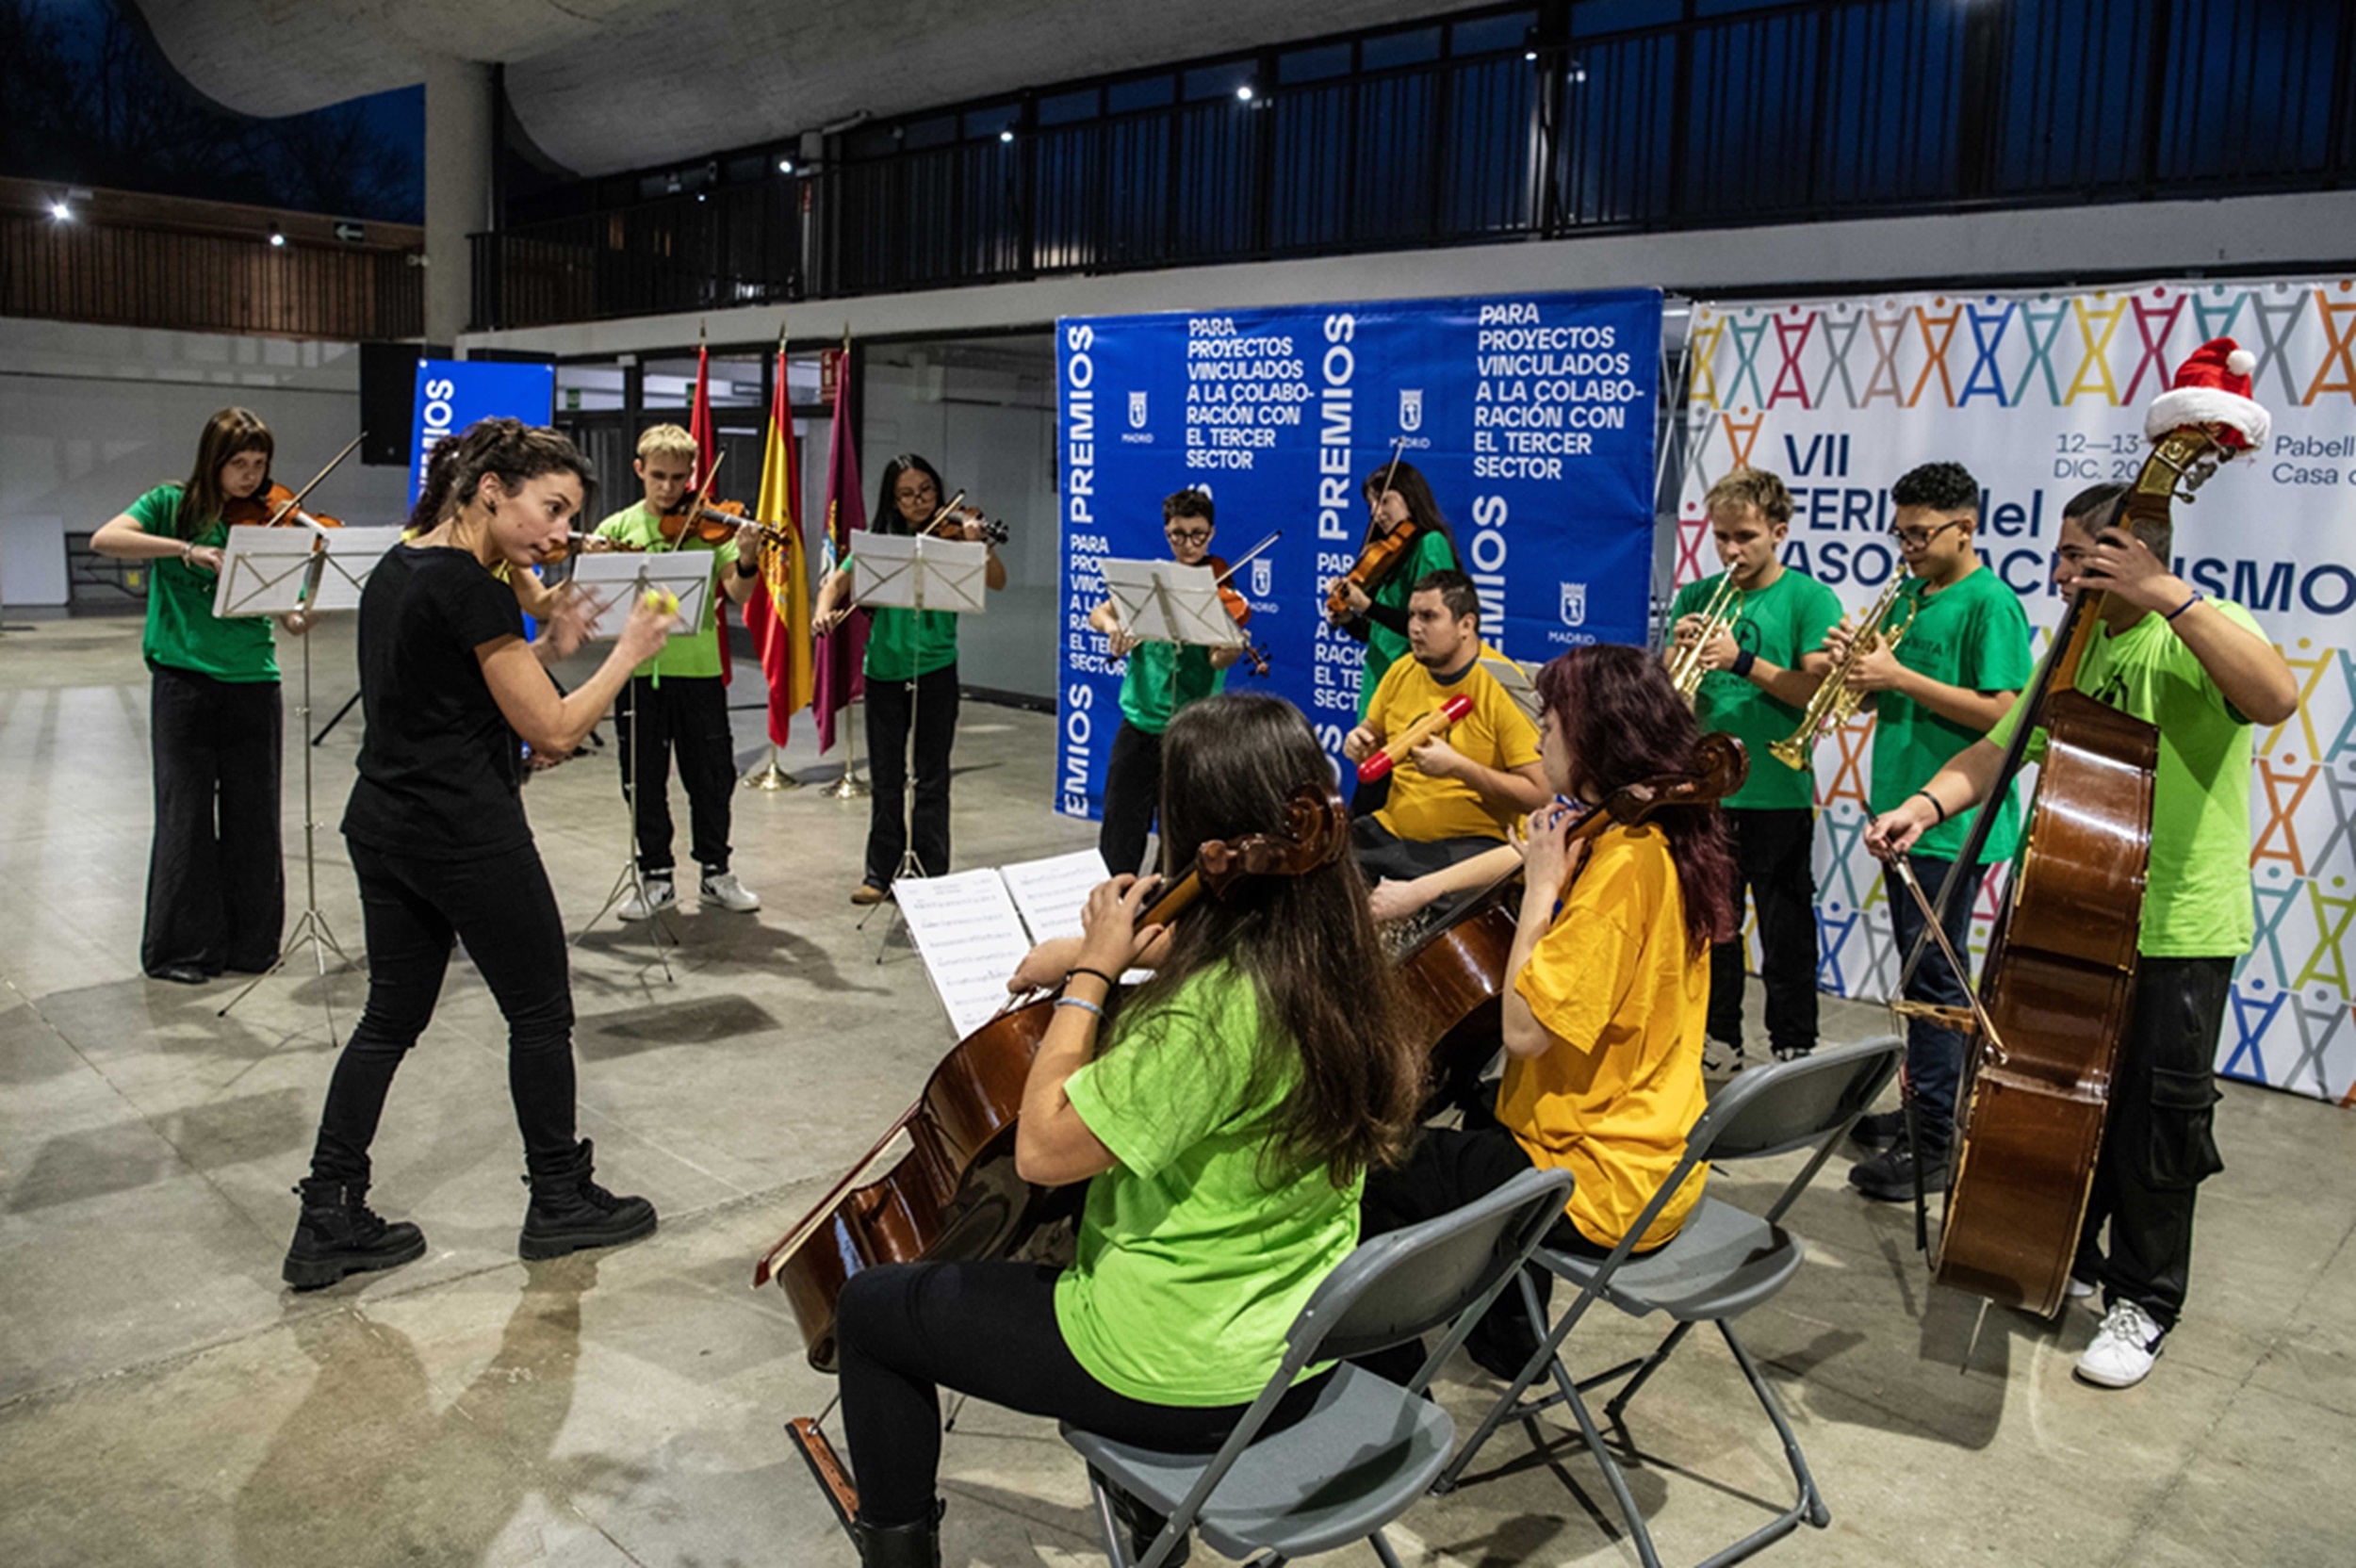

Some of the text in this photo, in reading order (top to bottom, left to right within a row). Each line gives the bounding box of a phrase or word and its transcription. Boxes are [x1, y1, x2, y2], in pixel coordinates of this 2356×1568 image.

[1479, 302, 1539, 325] PARA
[1189, 318, 1236, 336] PARA
[1187, 336, 1293, 359] PROYECTOS
[1478, 326, 1615, 351] PROYECTOS
[1187, 360, 1304, 381] VINCULADOS
[1478, 353, 1630, 377] VINCULADOS
[1187, 383, 1315, 402] A LA COLABO-
[1476, 380, 1644, 402] A LA COLABO-
[1068, 324, 1094, 524] PREMIOS
[1186, 402, 1301, 425] RACIÓN CON
[1475, 400, 1625, 429] RACIÓN CON
[1318, 313, 1355, 540] PREMIOS
[1121, 433, 1154, 443] MADRID
[1186, 428, 1275, 448] EL TERCER
[1475, 432, 1593, 454] EL TERCER
[1186, 449, 1253, 469] SECTOR
[1784, 433, 1850, 477] VII
[1474, 456, 1562, 480] SECTOR
[2053, 458, 2142, 480] DIC. 20
[2271, 461, 2339, 485] Casa
[1071, 533, 1110, 554] PARA
[1317, 552, 1355, 574] PAR
[1070, 594, 1082, 611] A
[1315, 620, 1331, 640] A
[1547, 630, 1596, 646] MADRID
[1070, 632, 1087, 651] EL
[1314, 665, 1335, 686] EL
